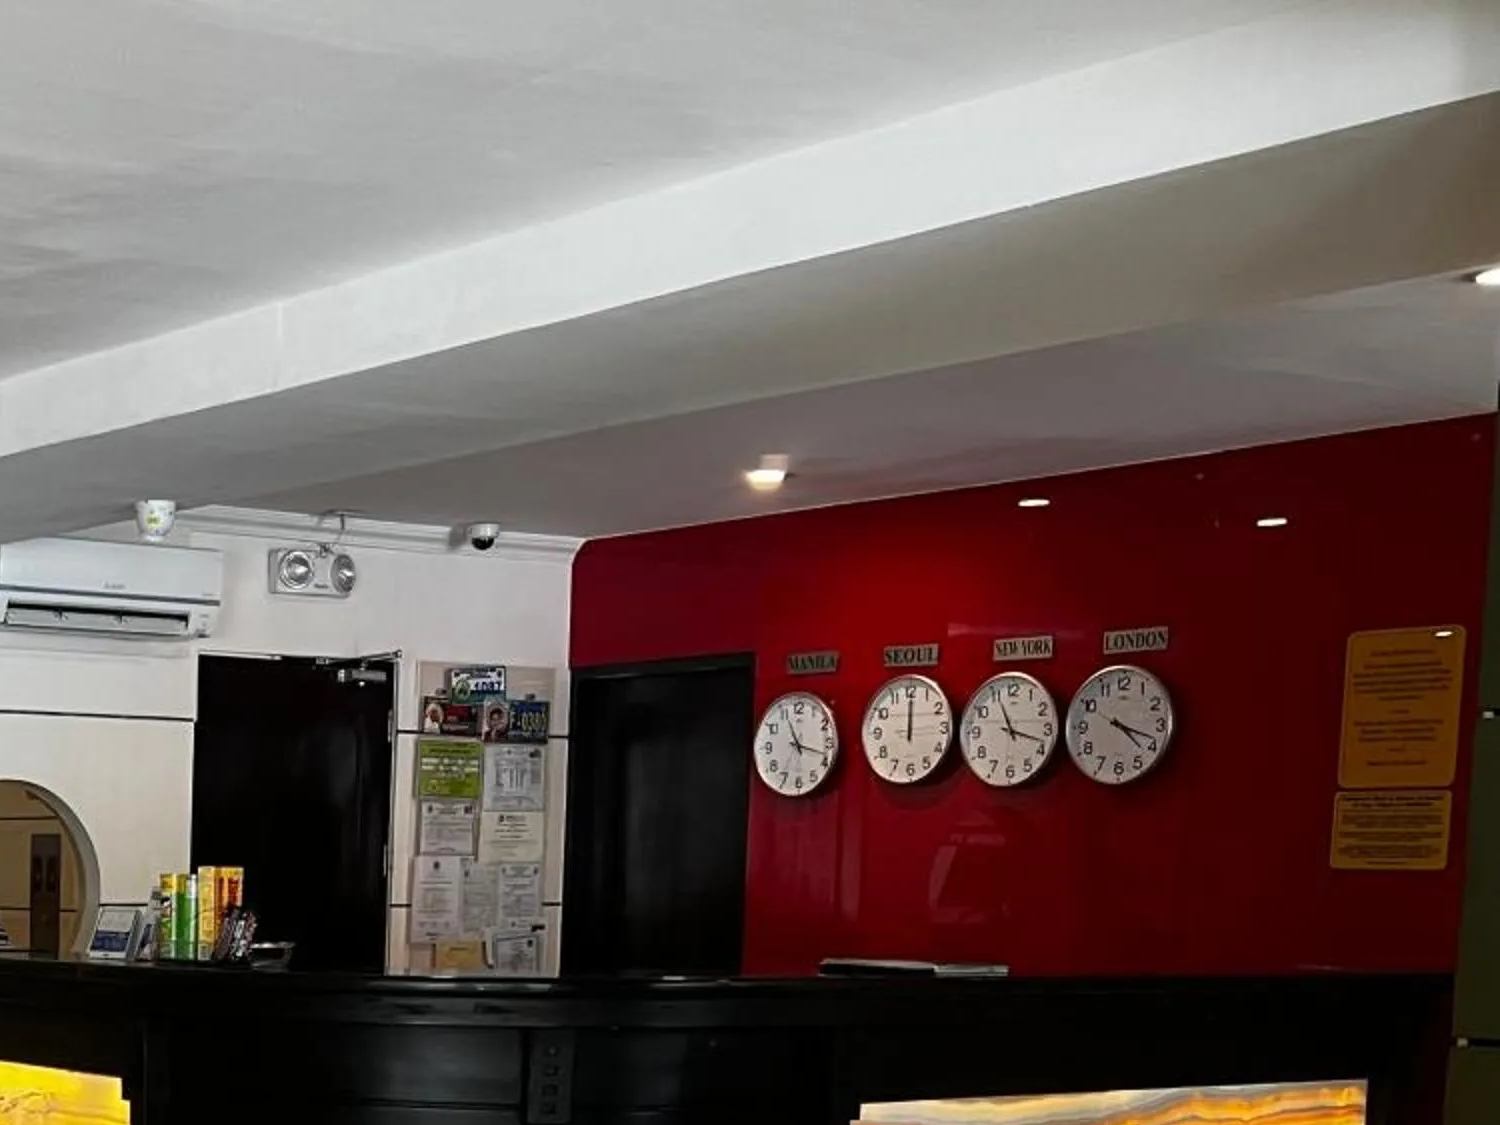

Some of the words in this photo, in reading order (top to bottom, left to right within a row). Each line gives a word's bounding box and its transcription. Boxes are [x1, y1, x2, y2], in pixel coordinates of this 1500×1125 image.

[995, 641, 1018, 657] NEW
[1021, 638, 1051, 656] YORK
[1105, 631, 1166, 651] LONDON
[885, 647, 934, 664] SEOUL
[1118, 677, 1130, 690] 12
[891, 690, 899, 704] 11
[905, 686, 916, 698] 12
[991, 688, 1000, 702] 11
[1008, 684, 1020, 697] 12
[1101, 684, 1110, 697] 11
[794, 701, 804, 715] 12
[934, 701, 943, 715] 2
[1038, 702, 1048, 716] 2
[1084, 699, 1096, 713] 10
[1150, 697, 1161, 711] 2
[878, 707, 889, 720] 10
[977, 705, 989, 718] 10
[820, 720, 829, 731] 2
[940, 721, 948, 734] 3
[1044, 723, 1052, 736] 3
[1078, 721, 1088, 734] 9
[1156, 718, 1165, 732] 3
[874, 727, 882, 740] 9
[971, 726, 980, 738] 9
[765, 741, 773, 755] 9
[879, 745, 888, 759] 8
[934, 742, 942, 753] 4
[977, 745, 986, 759] 8
[1036, 743, 1045, 756] 4
[1083, 742, 1093, 755] 8
[1148, 739, 1157, 752] 4
[891, 759, 899, 773] 7
[906, 763, 915, 776] 6
[922, 756, 931, 770] 5
[990, 760, 998, 773] 7
[1023, 759, 1033, 772] 5
[1097, 756, 1106, 770] 7
[1114, 762, 1124, 775] 6
[1133, 756, 1143, 770] 5
[809, 770, 818, 782] 5
[1005, 765, 1015, 778] 6
[780, 772, 788, 786] 7
[795, 777, 803, 789] 6
